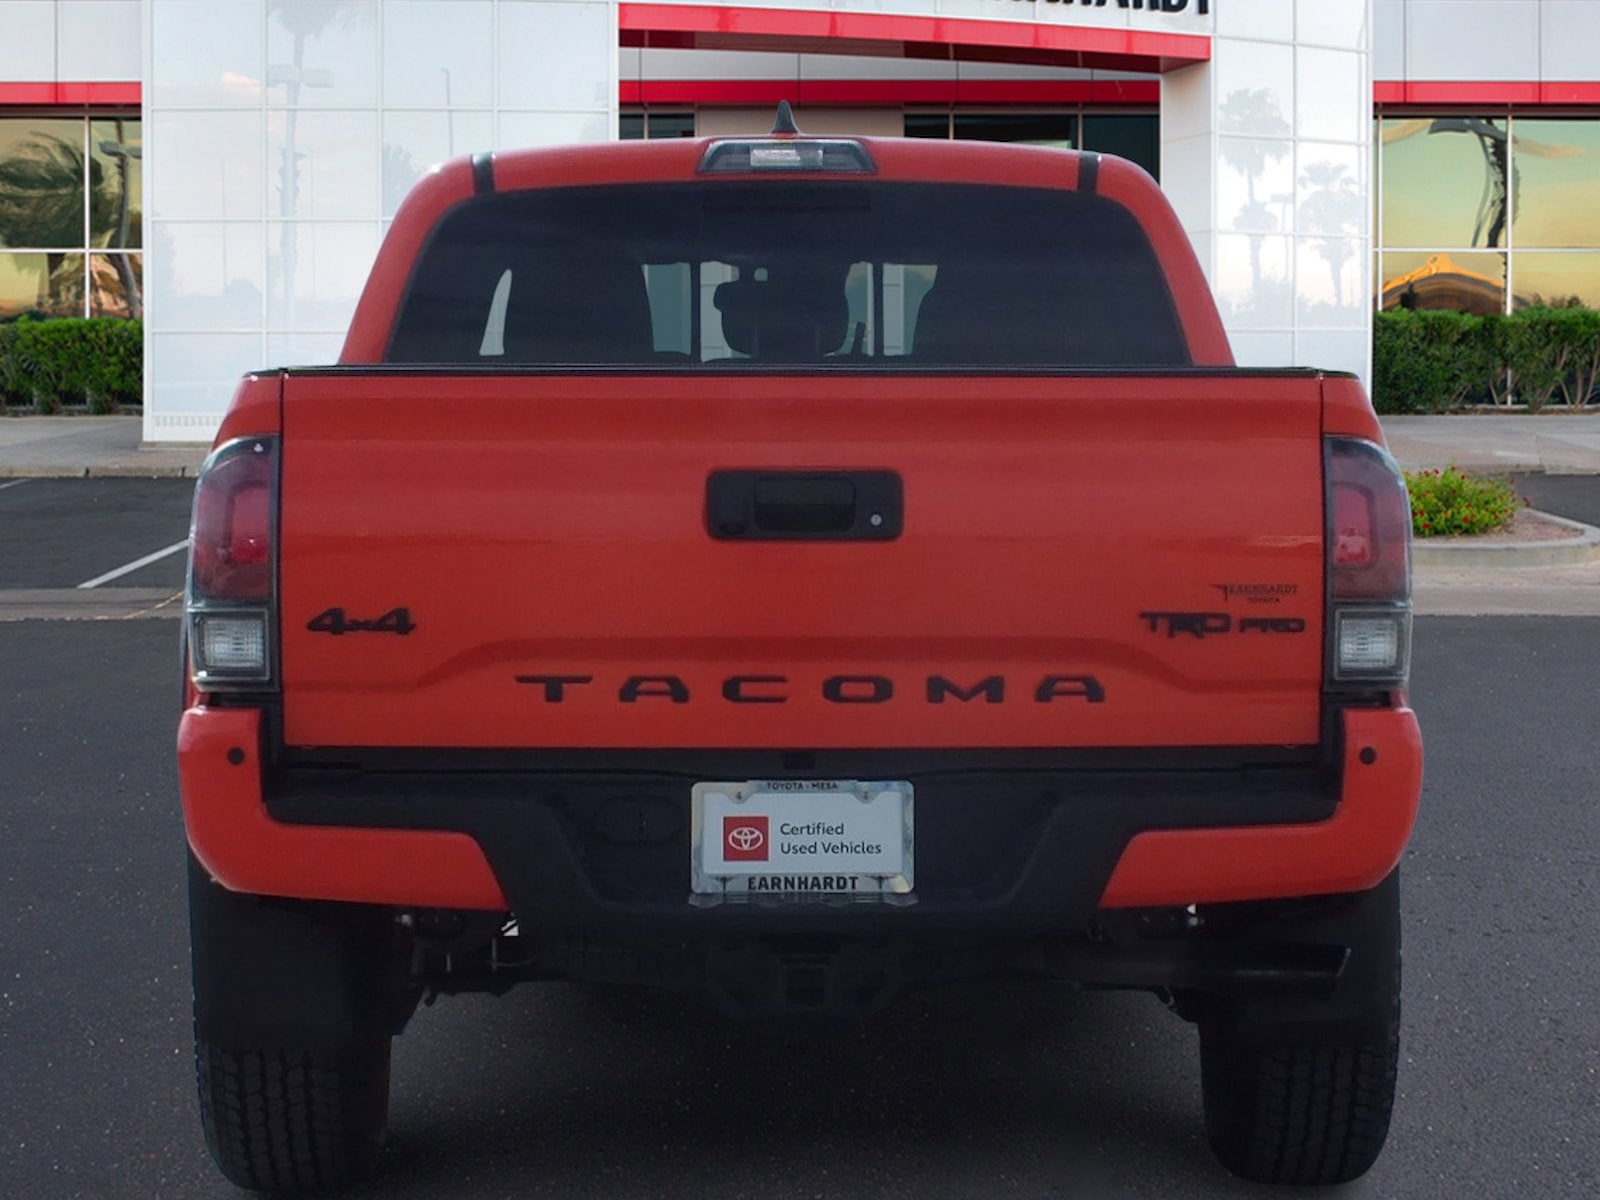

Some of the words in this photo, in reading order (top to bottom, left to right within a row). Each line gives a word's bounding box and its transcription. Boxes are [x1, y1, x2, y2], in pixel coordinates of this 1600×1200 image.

[1139, 612, 1231, 639] TRD
[1238, 617, 1305, 634] PRO
[515, 674, 1106, 703] TACOMA
[766, 782, 803, 790] TOYOTA
[811, 782, 837, 790] MESA
[779, 822, 845, 836] Certified
[779, 841, 818, 855] Used
[821, 841, 882, 855] Vehicles
[747, 876, 859, 891] EARNHARDT
